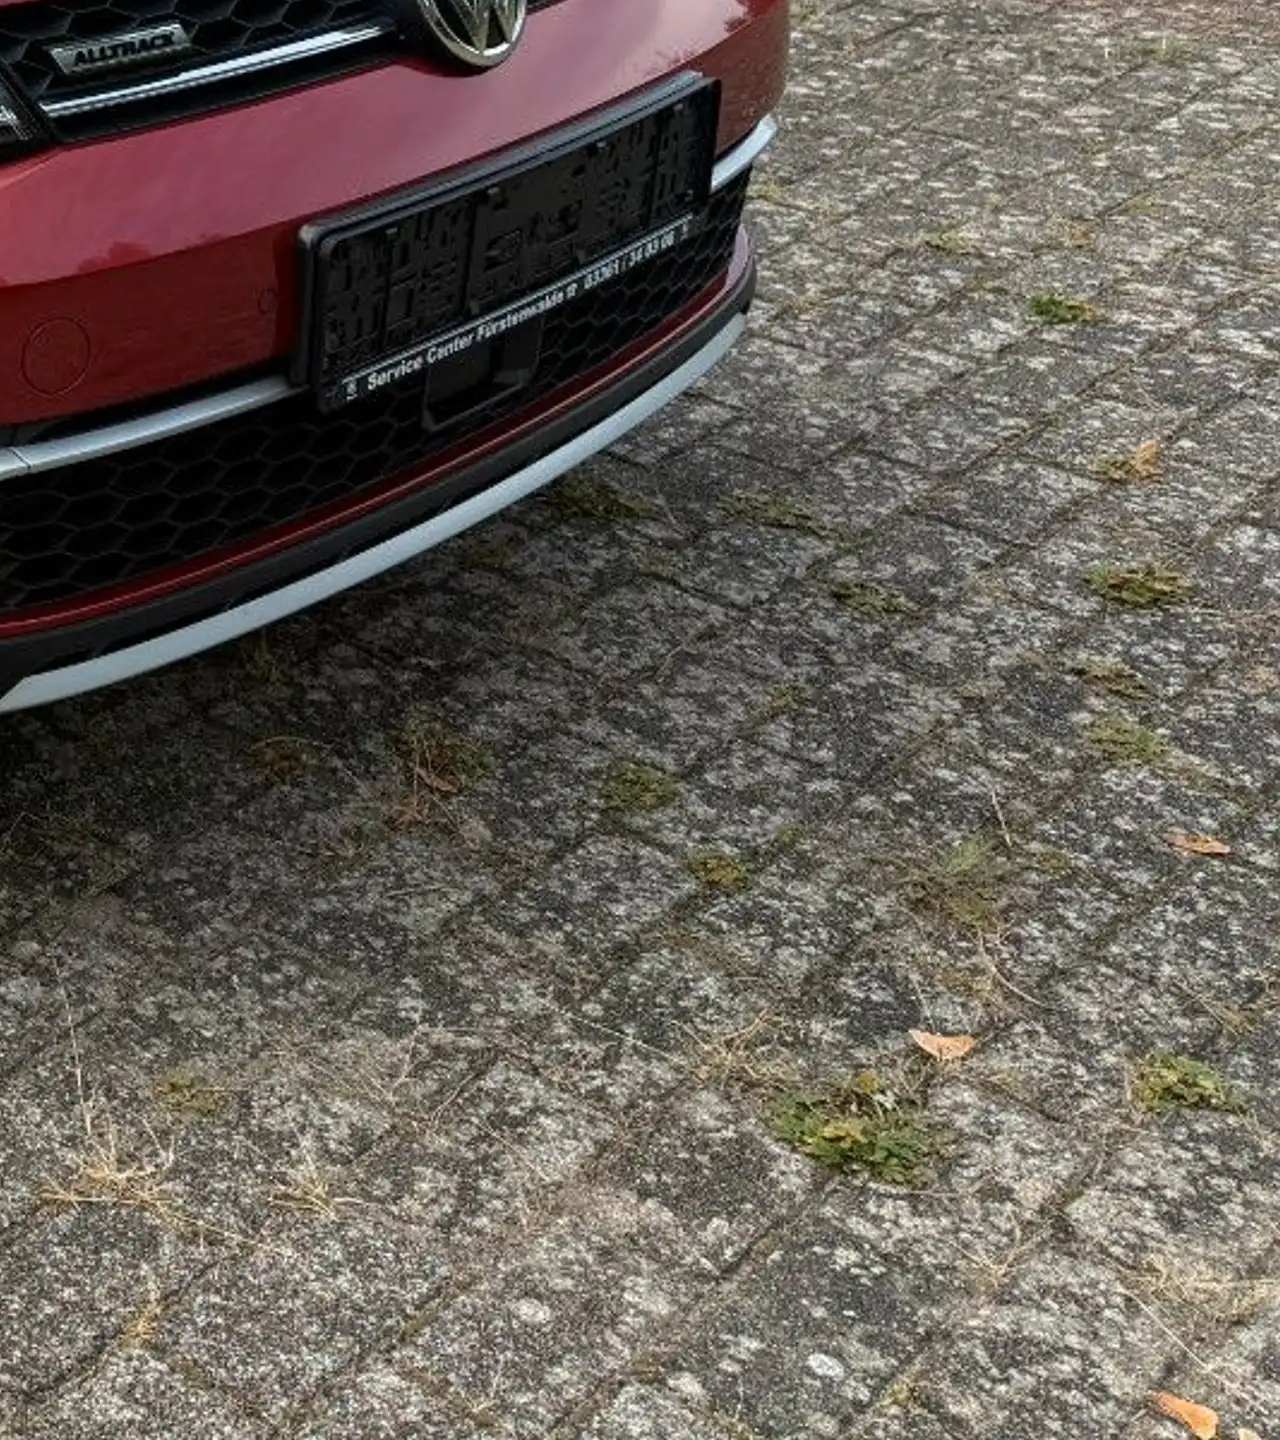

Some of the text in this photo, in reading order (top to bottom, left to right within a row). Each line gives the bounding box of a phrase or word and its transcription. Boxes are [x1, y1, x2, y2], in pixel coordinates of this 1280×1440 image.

[74, 31, 175, 66] ALLTRACK
[367, 355, 423, 391] Service
[426, 332, 474, 364] Center
